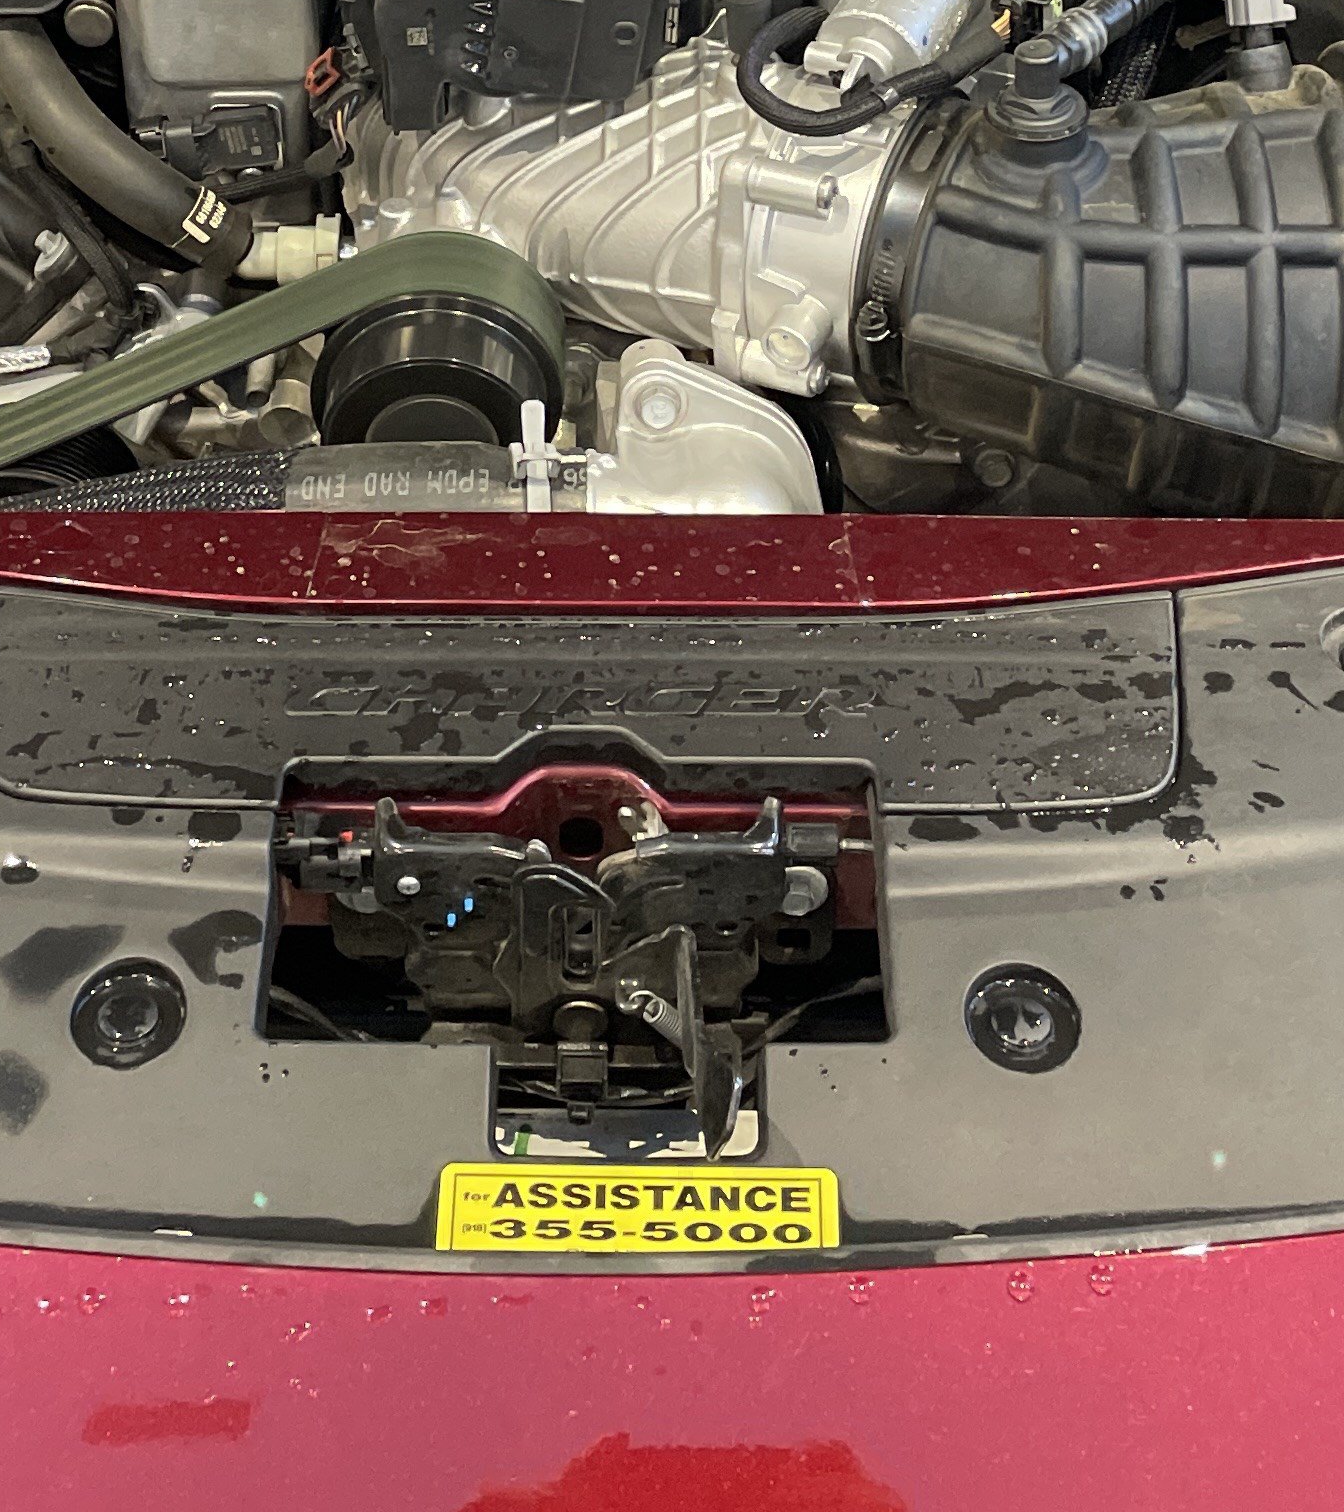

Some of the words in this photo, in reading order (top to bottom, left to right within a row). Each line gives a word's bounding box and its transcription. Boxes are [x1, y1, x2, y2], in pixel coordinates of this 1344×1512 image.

[301, 474, 346, 501] END
[364, 471, 410, 497] RAD
[427, 469, 490, 495] EPDM
[463, 1192, 490, 1201] for
[492, 1183, 811, 1212] ASSISTANCE
[489, 1219, 813, 1244] 355-5000
